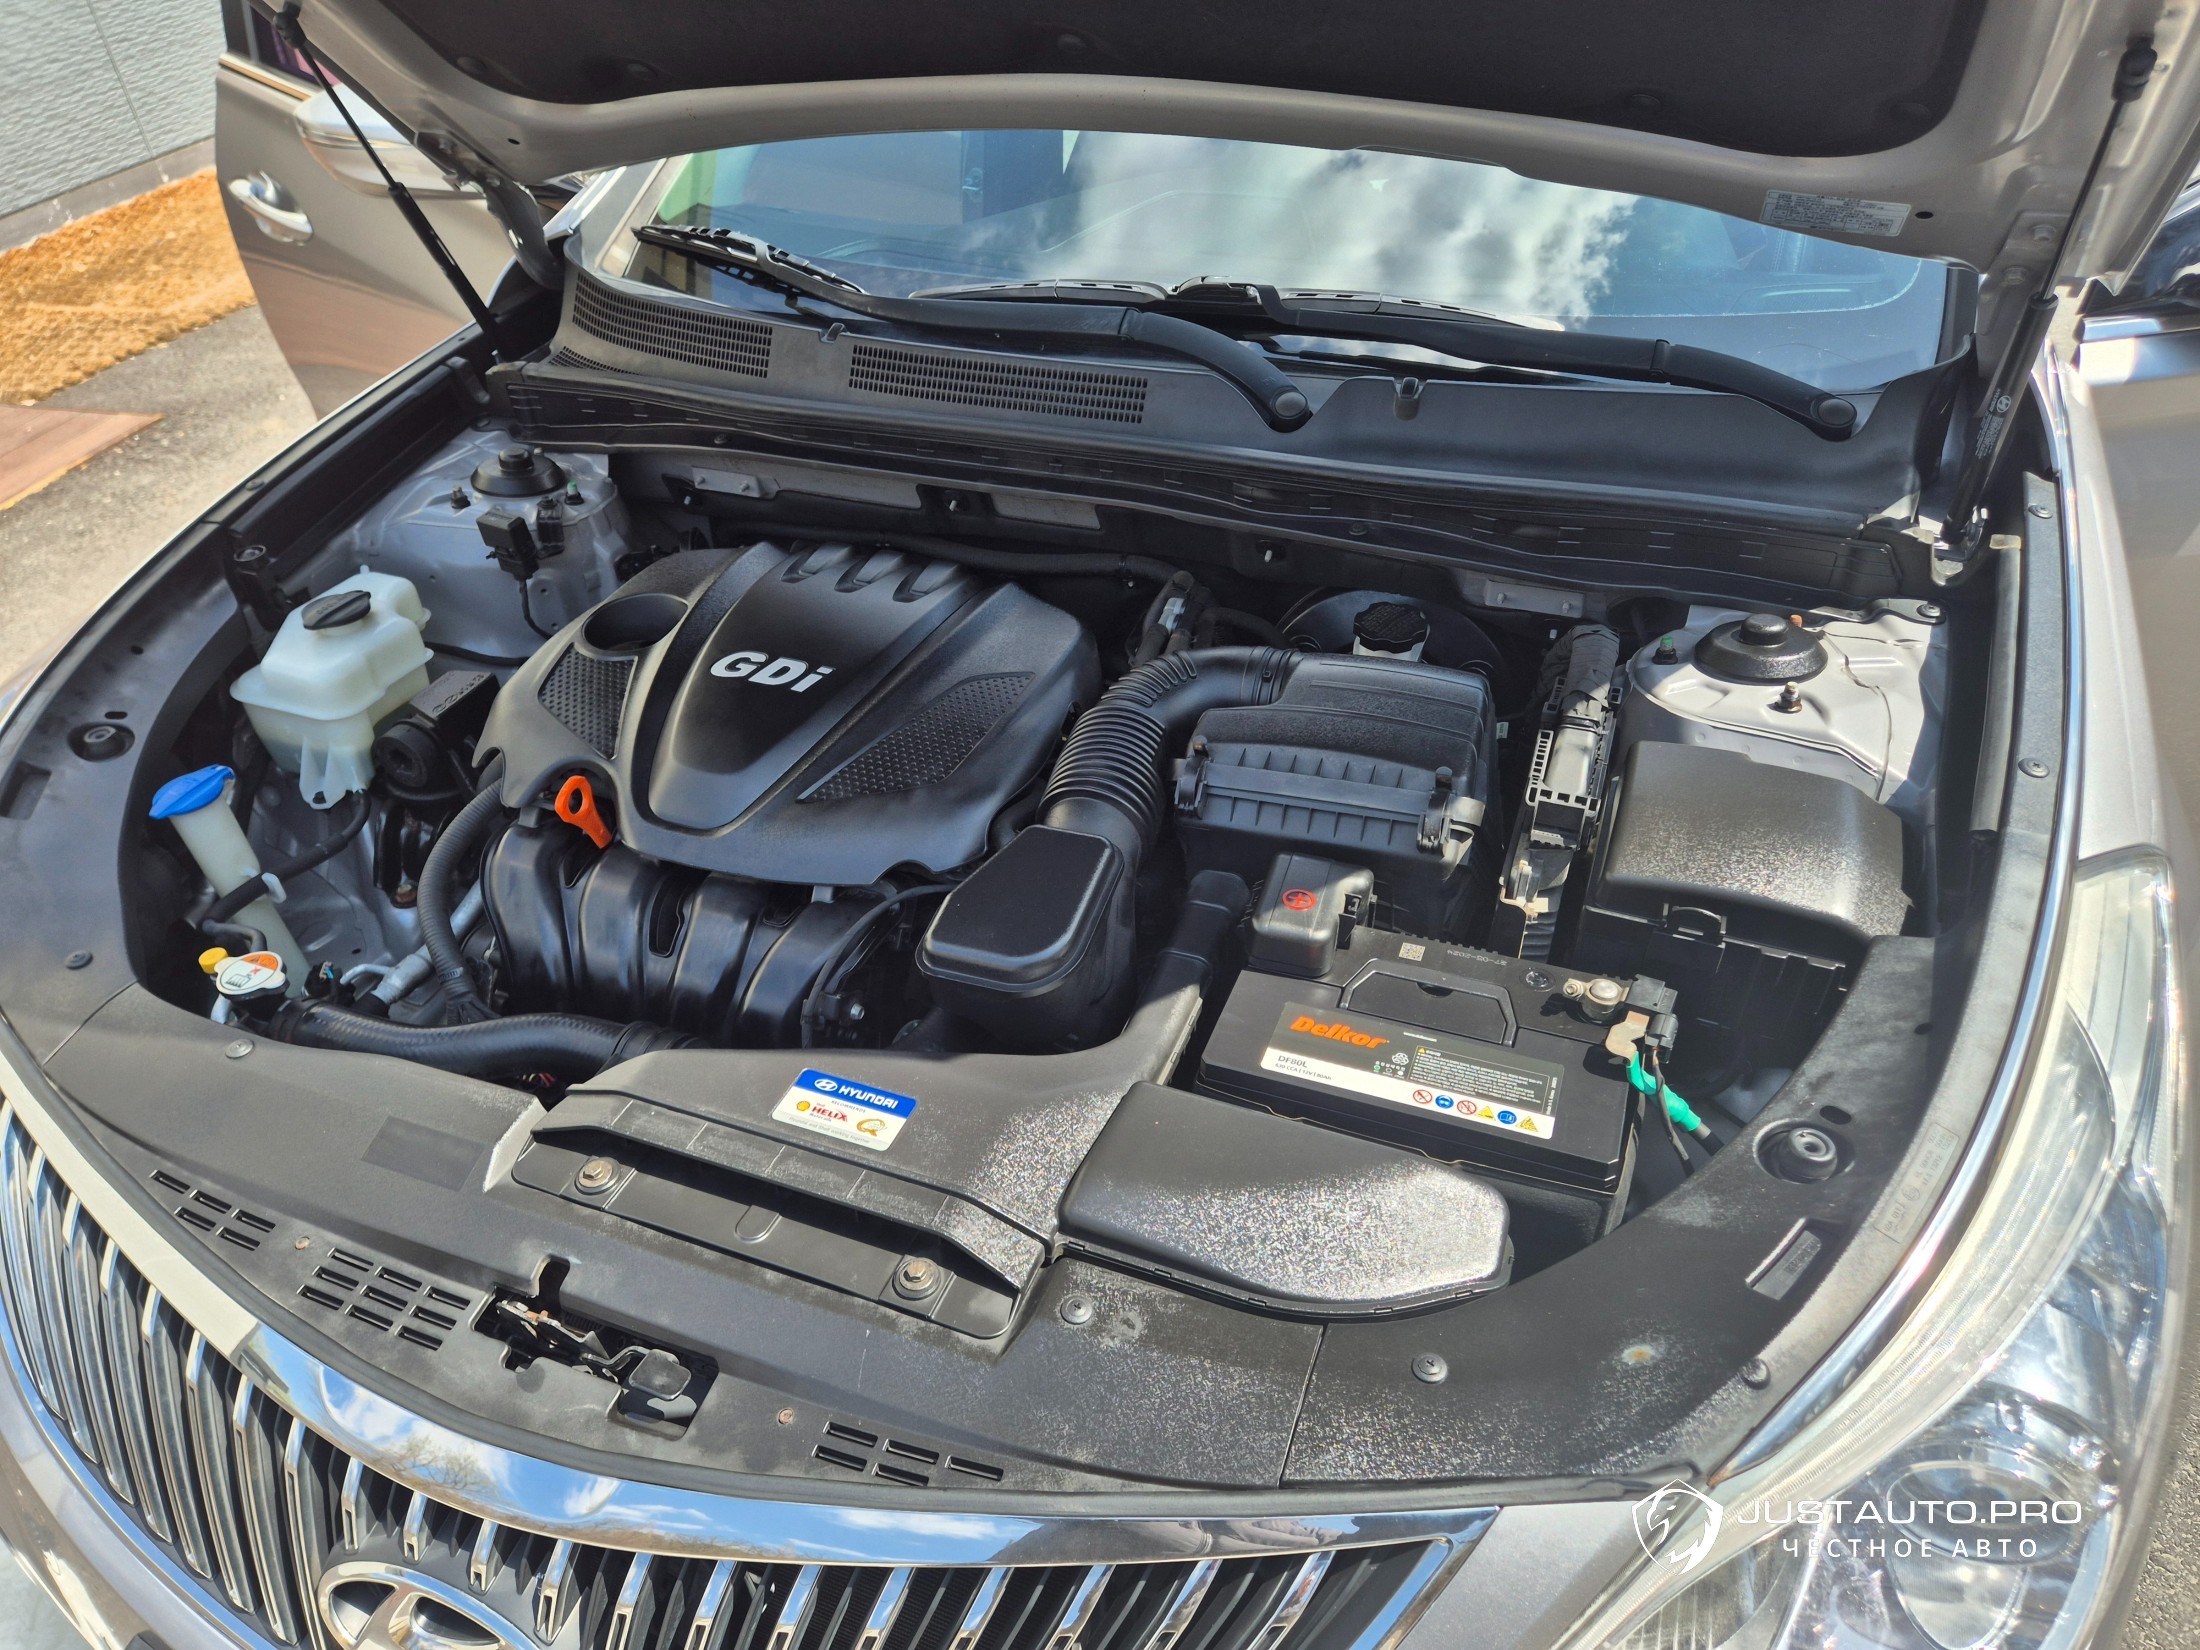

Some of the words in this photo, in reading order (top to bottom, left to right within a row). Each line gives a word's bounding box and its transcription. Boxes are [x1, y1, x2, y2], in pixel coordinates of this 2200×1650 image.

[710, 651, 836, 692] GDi
[1290, 1016, 1387, 1049] Delkor
[1278, 1055, 1308, 1068] DF80L
[838, 1085, 899, 1110] HYUNDAI
[812, 1106, 847, 1122] HELIX
